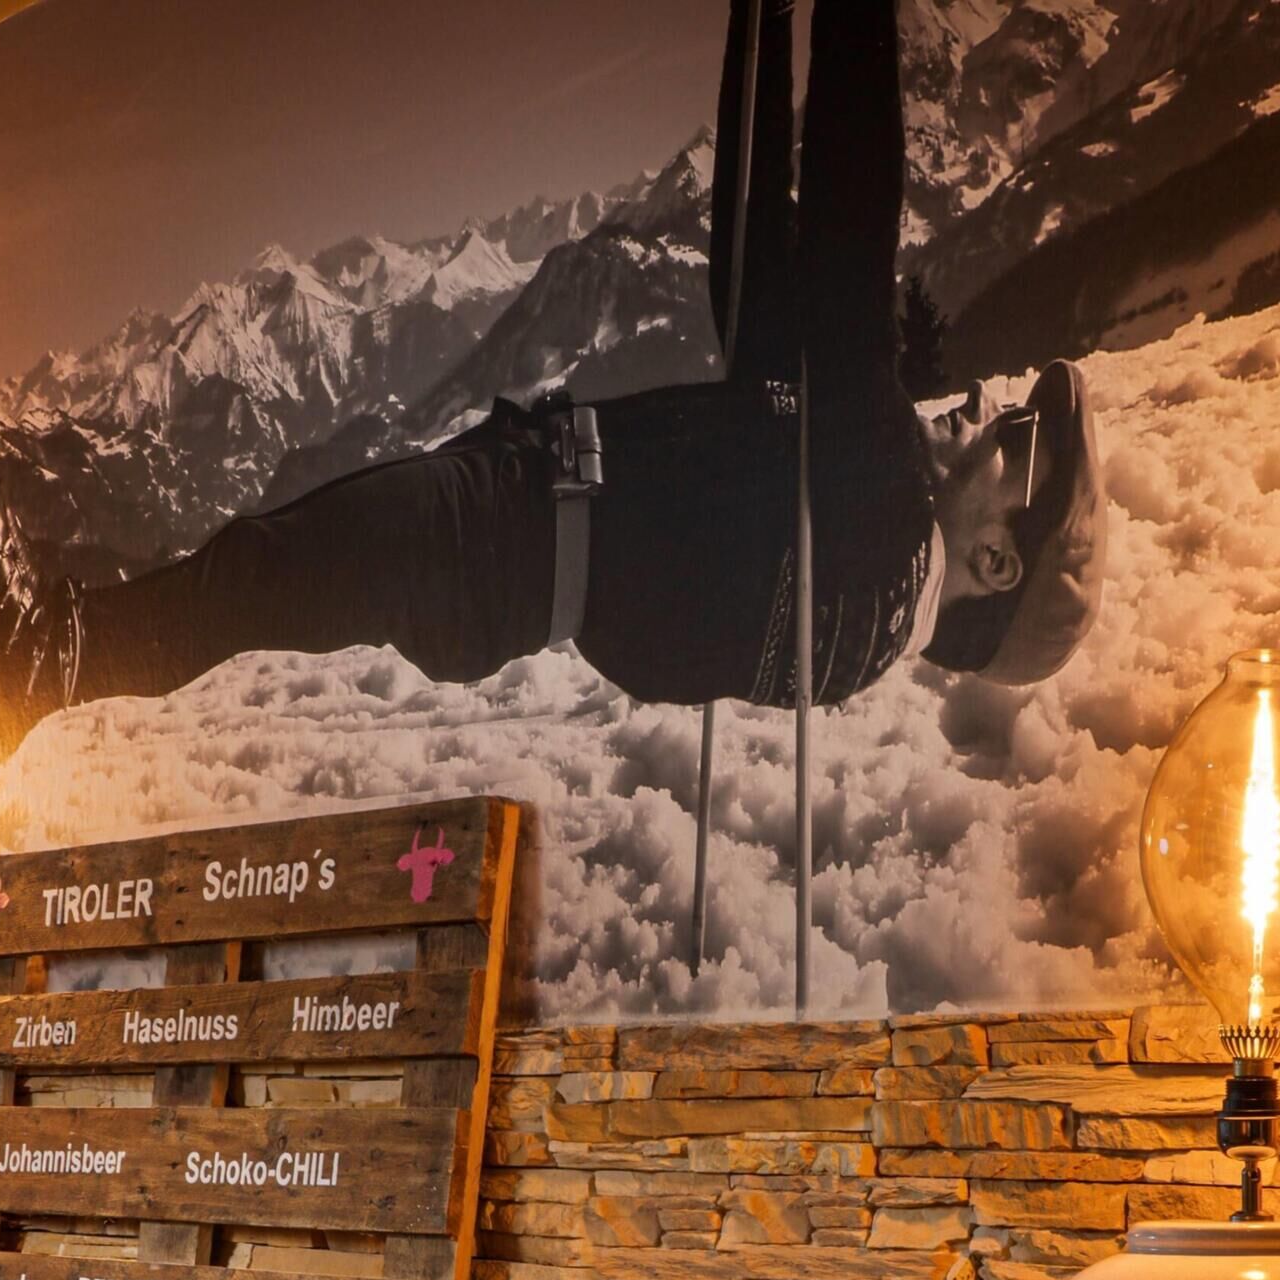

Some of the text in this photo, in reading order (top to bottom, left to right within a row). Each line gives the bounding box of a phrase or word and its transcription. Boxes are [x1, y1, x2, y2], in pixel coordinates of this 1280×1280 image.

[43, 879, 152, 926] TIROLER
[13, 996, 399, 1047] Zirben Haselnuss Himbeer
[186, 1152, 338, 1185] Schoko-CHILI
